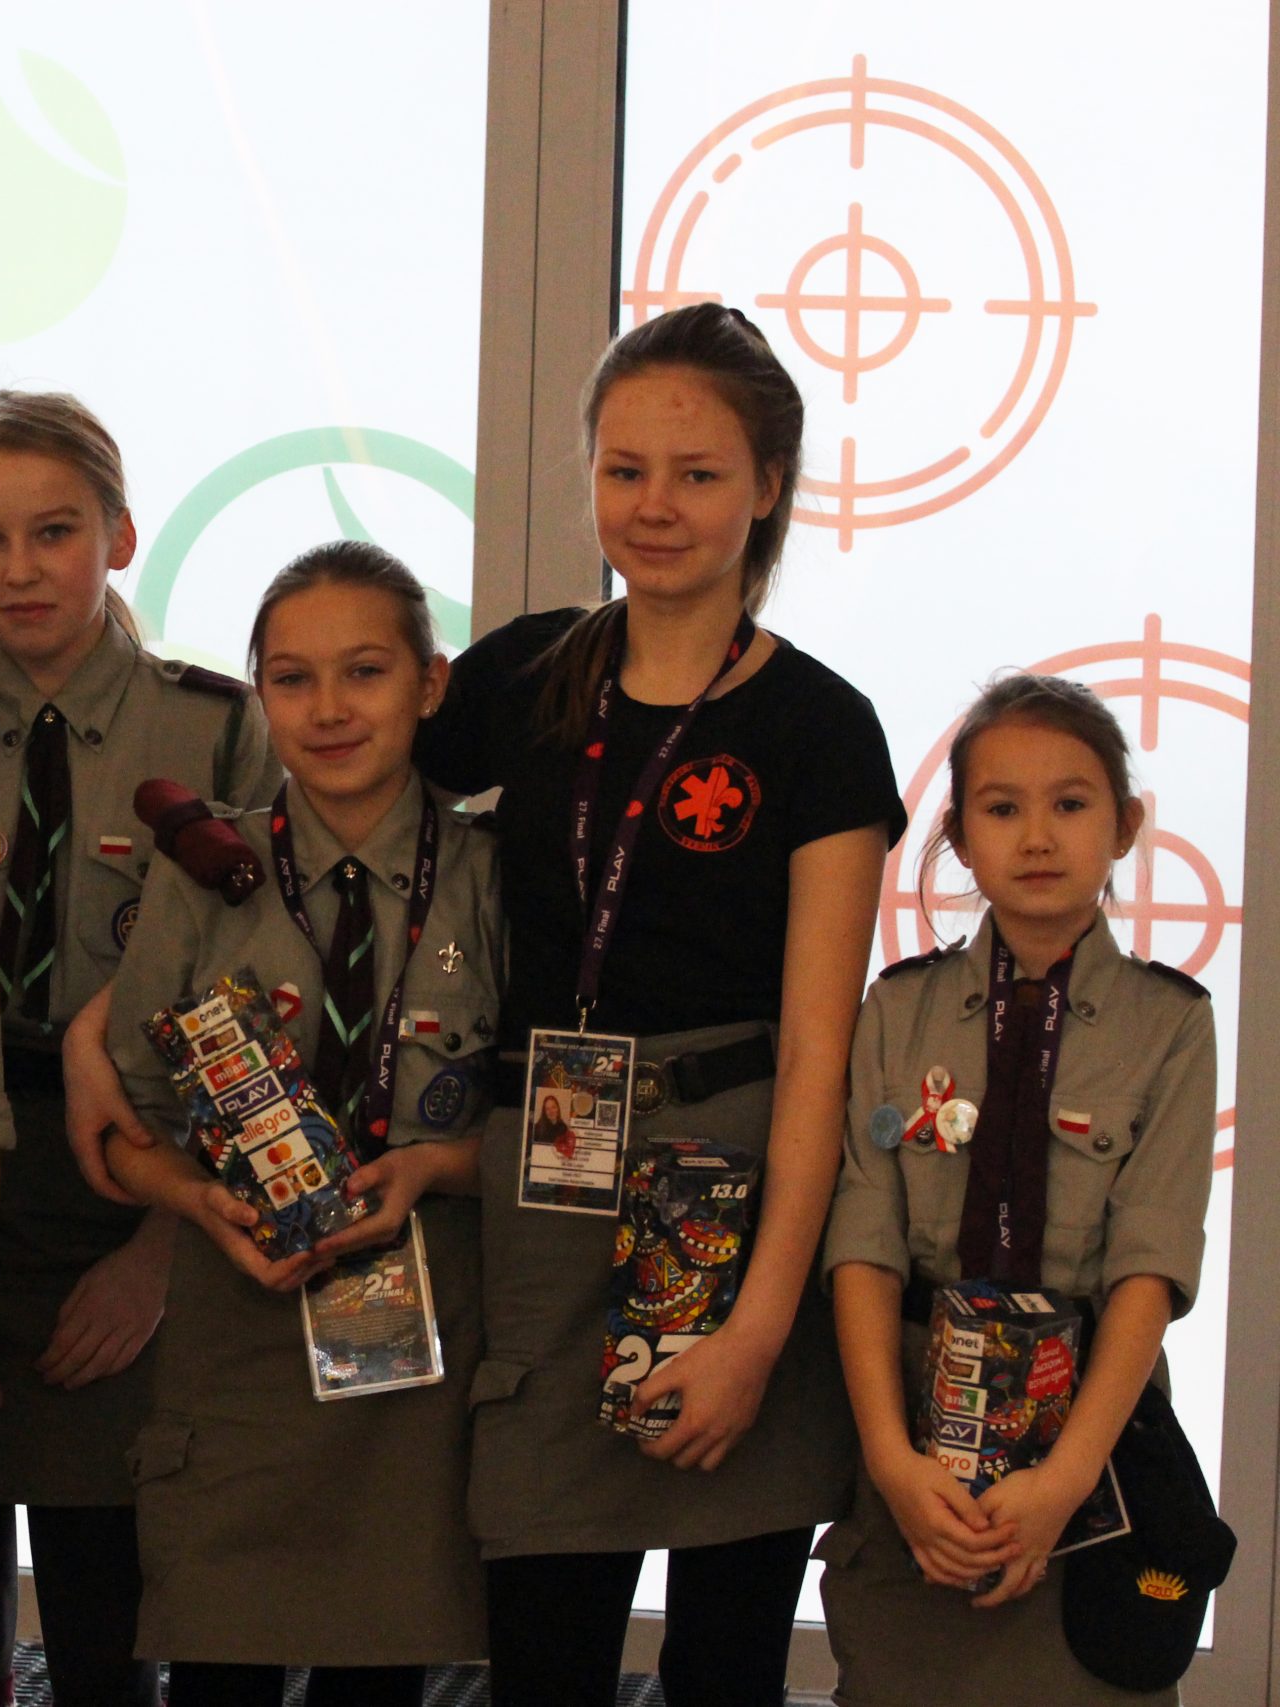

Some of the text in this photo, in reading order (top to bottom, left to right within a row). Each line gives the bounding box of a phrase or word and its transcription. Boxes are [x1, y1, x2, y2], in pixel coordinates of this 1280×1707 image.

[576, 817, 586, 839] Final
[418, 857, 432, 900] PLAY
[607, 844, 626, 893] PLAY
[597, 909, 611, 934] Final
[997, 961, 1008, 983] Final
[199, 1002, 227, 1024] onet
[386, 1002, 398, 1025] Final
[995, 1000, 1006, 1042] PLAY
[1045, 985, 1060, 1032] PLAY
[214, 1053, 256, 1085] mBank
[378, 1043, 392, 1090] PLAY
[594, 1053, 624, 1073] 27
[224, 1081, 272, 1113] PLAY
[239, 1108, 292, 1144] allegro
[709, 1183, 748, 1200] 13.0
[999, 1201, 1010, 1249] PLAY
[363, 1264, 405, 1298] 27
